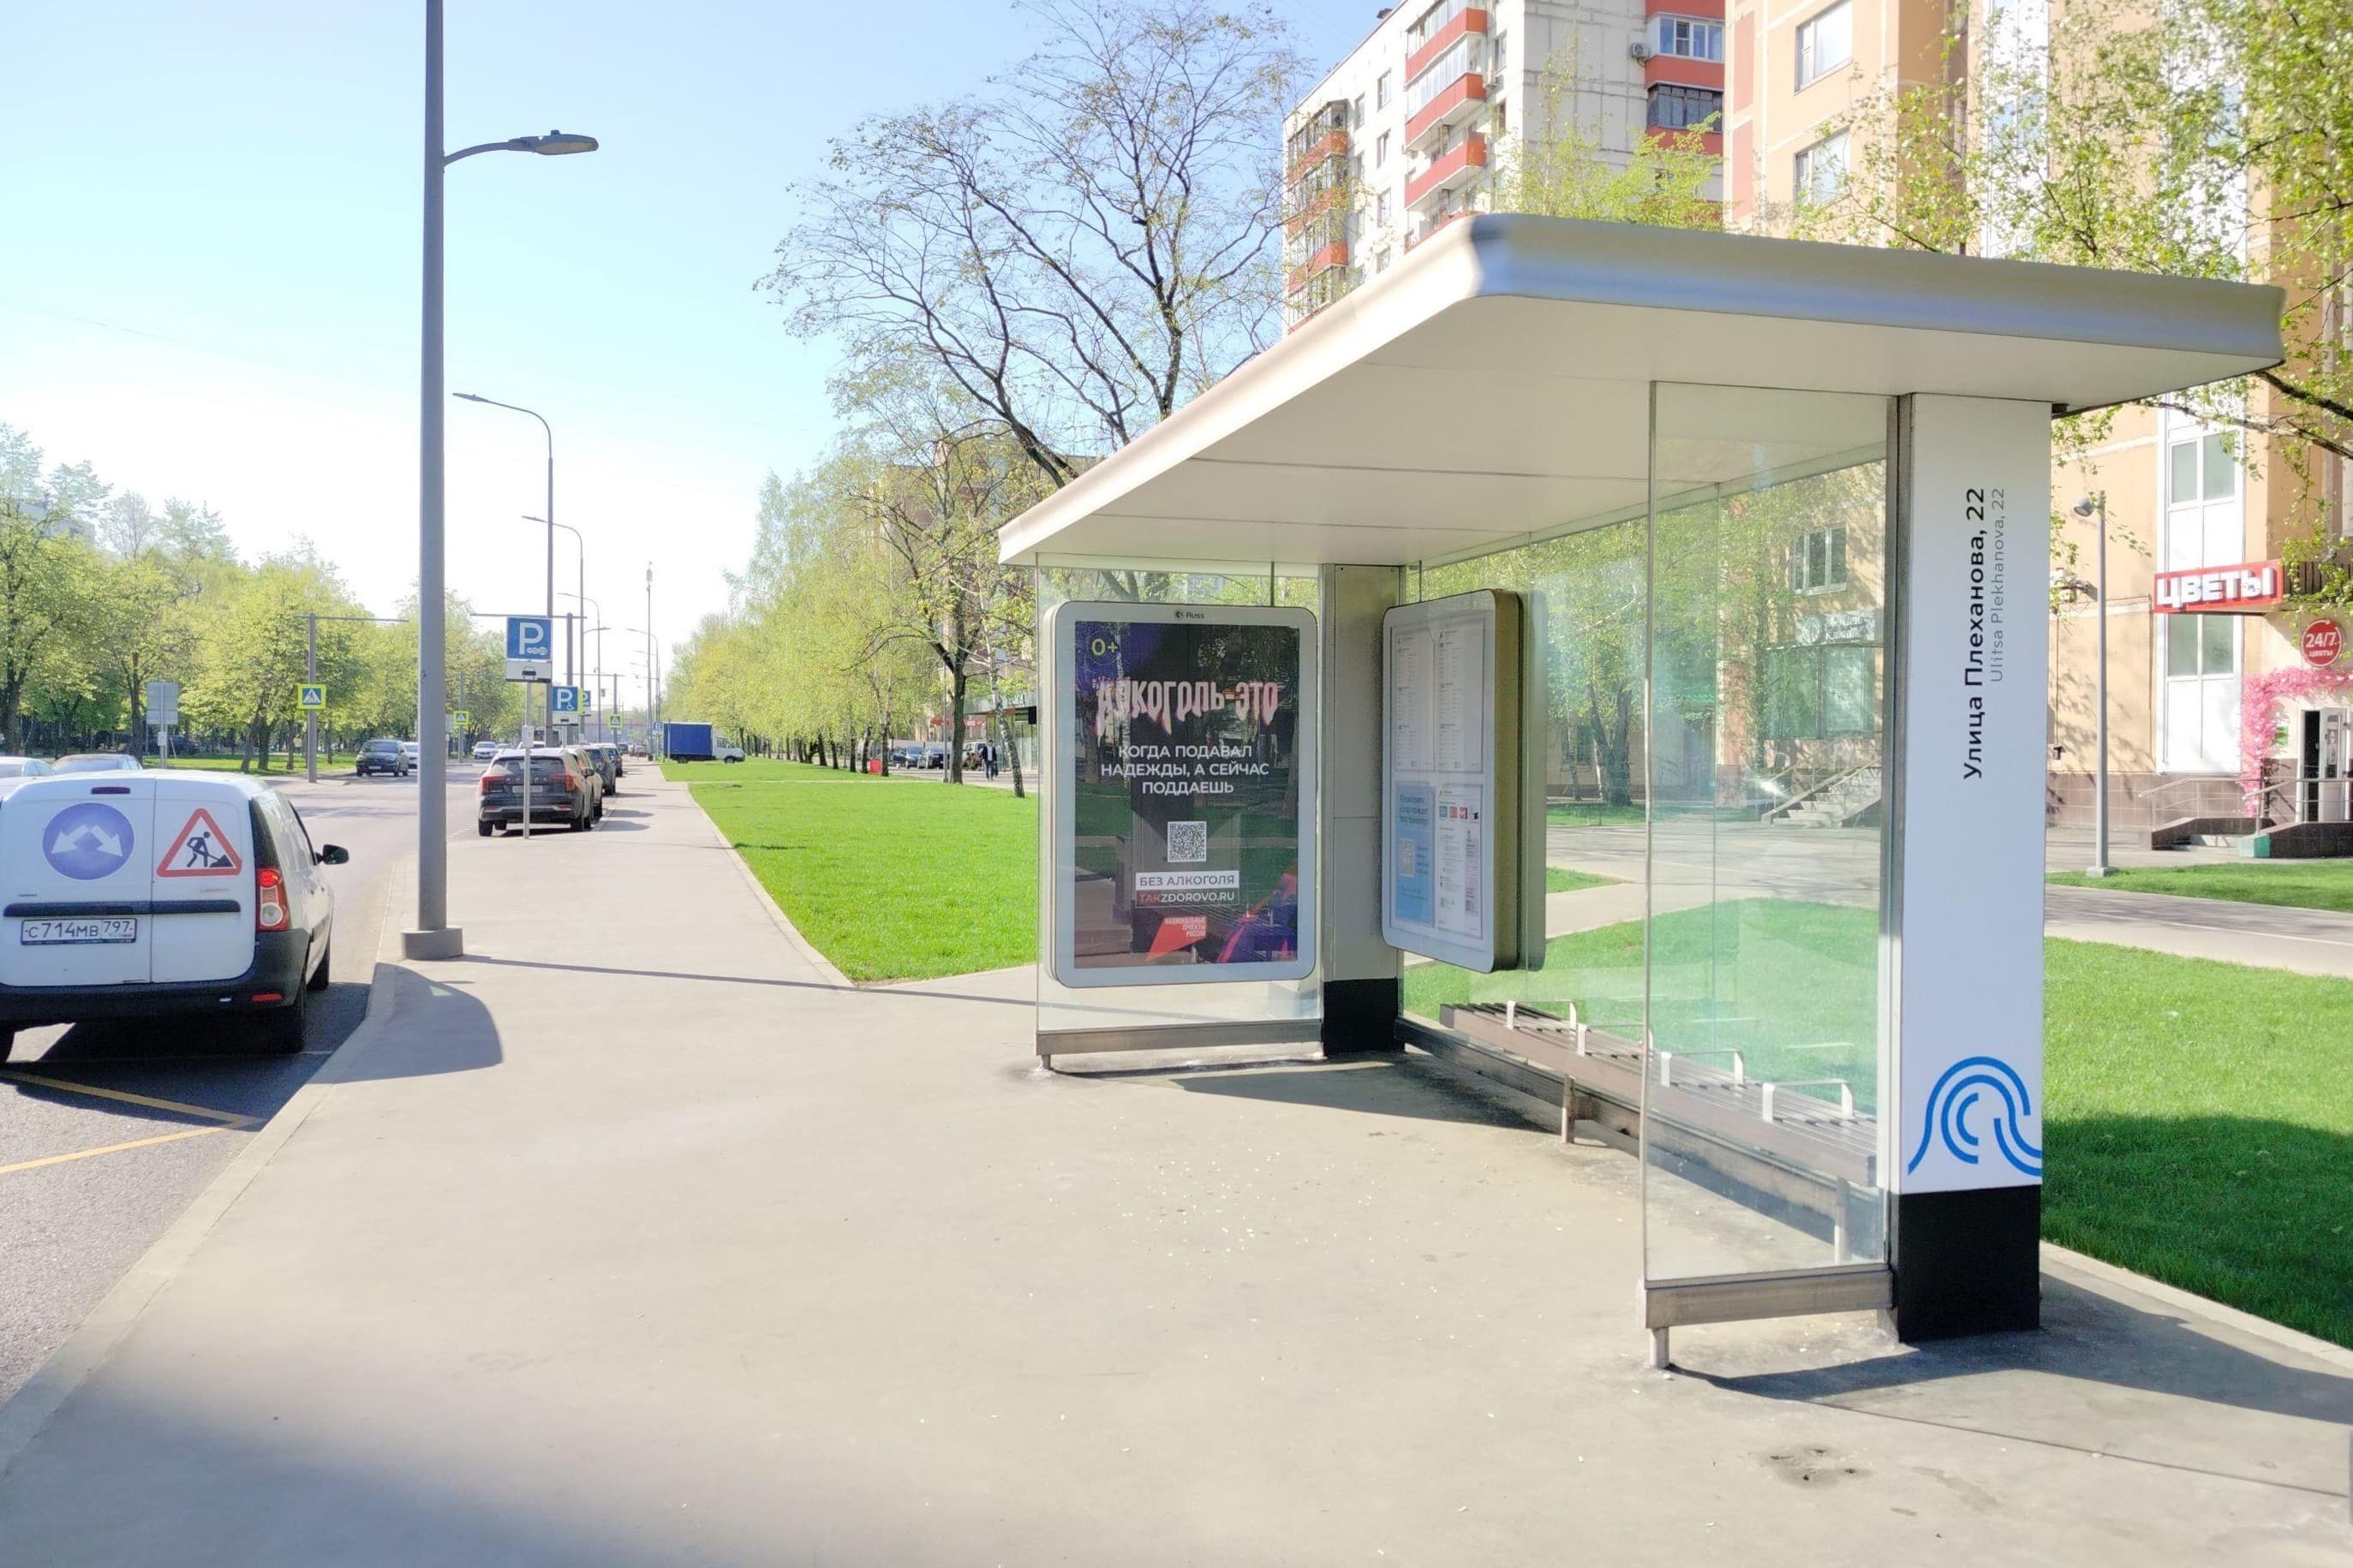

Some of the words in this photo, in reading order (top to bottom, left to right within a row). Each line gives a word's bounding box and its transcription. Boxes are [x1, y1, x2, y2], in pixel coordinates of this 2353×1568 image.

[1967, 487, 1985, 521] 22
[1992, 488, 2004, 511] 22
[1991, 515, 2007, 623] Plekhanova,
[2156, 567, 2277, 608] ЦВЕТЫ
[1965, 528, 1988, 686] Плеханова,
[1091, 638, 1119, 657] 0+
[2305, 631, 2337, 648] 24/7
[1991, 629, 2004, 683] Ulitsa
[1964, 696, 1986, 779] Улица
[1119, 745, 1171, 760] КОГДА
[1175, 745, 1252, 760] ПОДАВАЛ
[1101, 763, 1191, 778] НАДЕЖДЫ,
[1194, 764, 1206, 775] А
[1209, 760, 1269, 776] СЕЙЧАС
[1142, 781, 1234, 796] ПОДДАЕШЬ
[1139, 876, 1163, 886] БЕЗ
[1167, 875, 1234, 886] АЛКОГОЛЯ
[1139, 891, 1234, 903] TAKZDOROVO.RU
